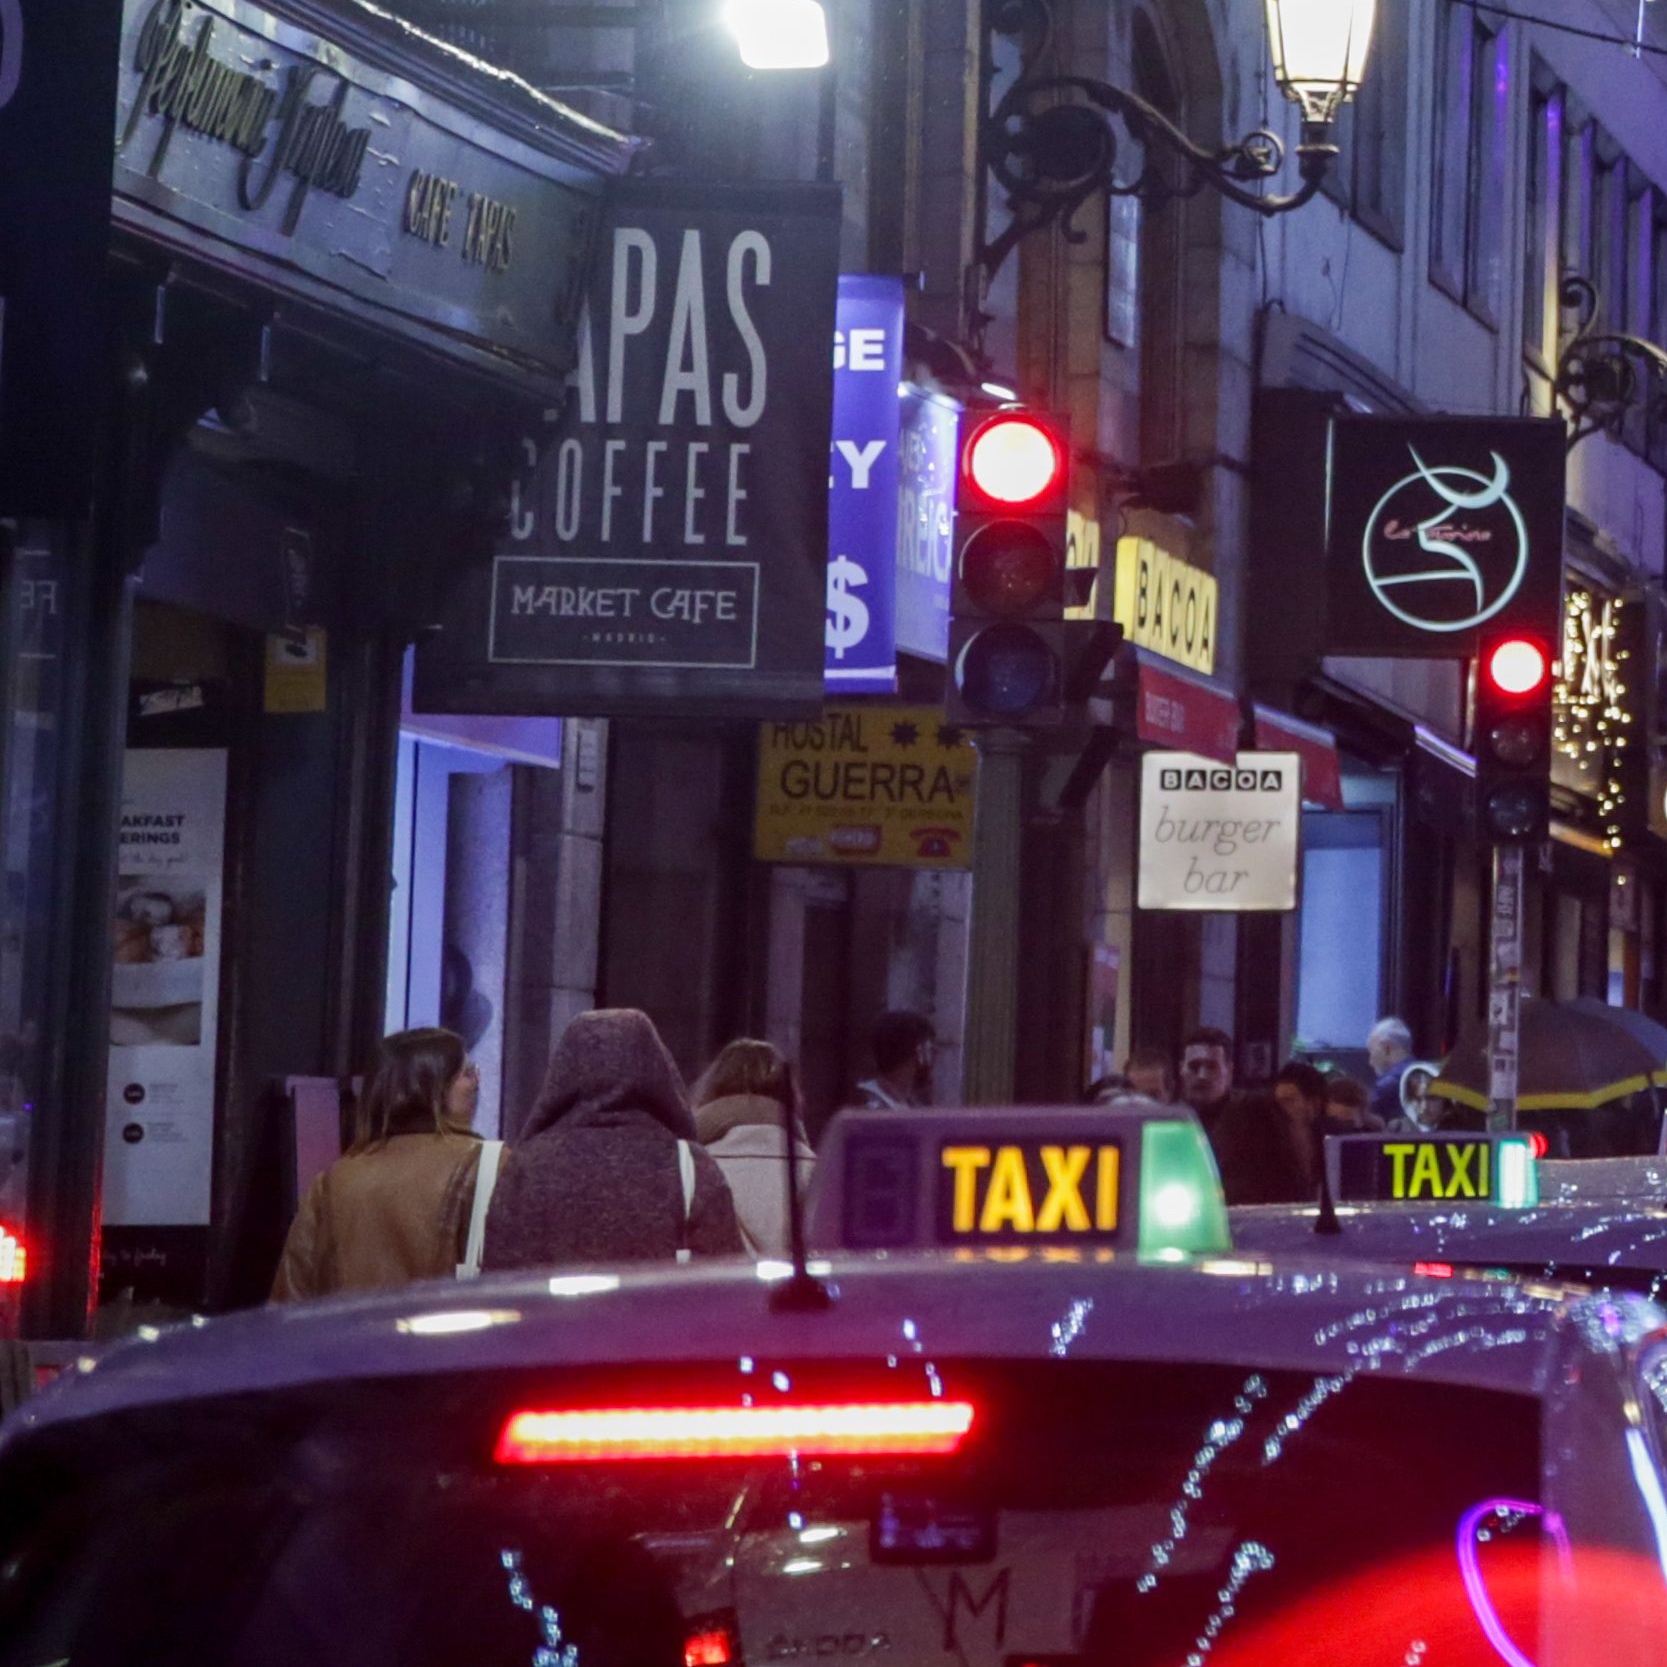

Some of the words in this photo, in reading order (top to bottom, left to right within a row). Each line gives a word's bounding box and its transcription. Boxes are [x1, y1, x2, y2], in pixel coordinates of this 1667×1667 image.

[508, 437, 751, 546] COFFEE
[511, 585, 641, 618] MARKET
[650, 587, 737, 623] CAFE
[1136, 558, 1214, 665] BACOA
[779, 759, 956, 805] GUERRA
[1161, 769, 1282, 792] BACOA
[1153, 805, 1282, 856] burger
[1182, 857, 1250, 895] bar
[942, 1146, 1120, 1233] TAXI
[1383, 1143, 1489, 1200] TAXI
